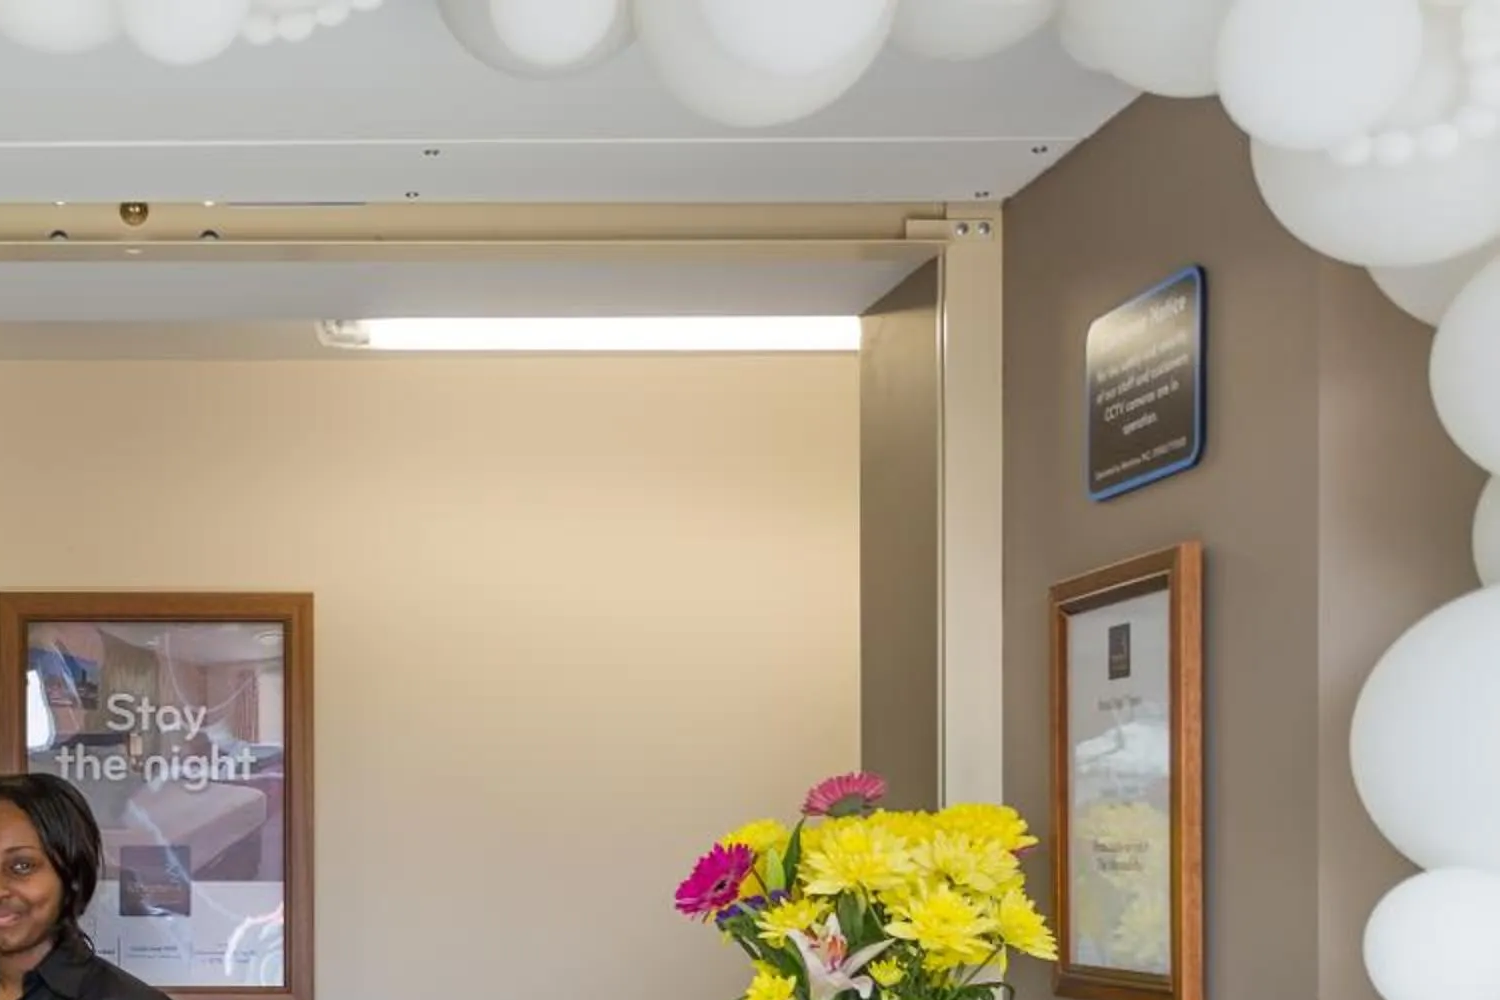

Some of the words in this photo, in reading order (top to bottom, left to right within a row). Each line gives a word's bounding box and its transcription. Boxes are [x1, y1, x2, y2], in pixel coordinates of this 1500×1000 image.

[106, 693, 208, 740] Stay
[56, 743, 127, 781] the
[145, 743, 258, 791] night
